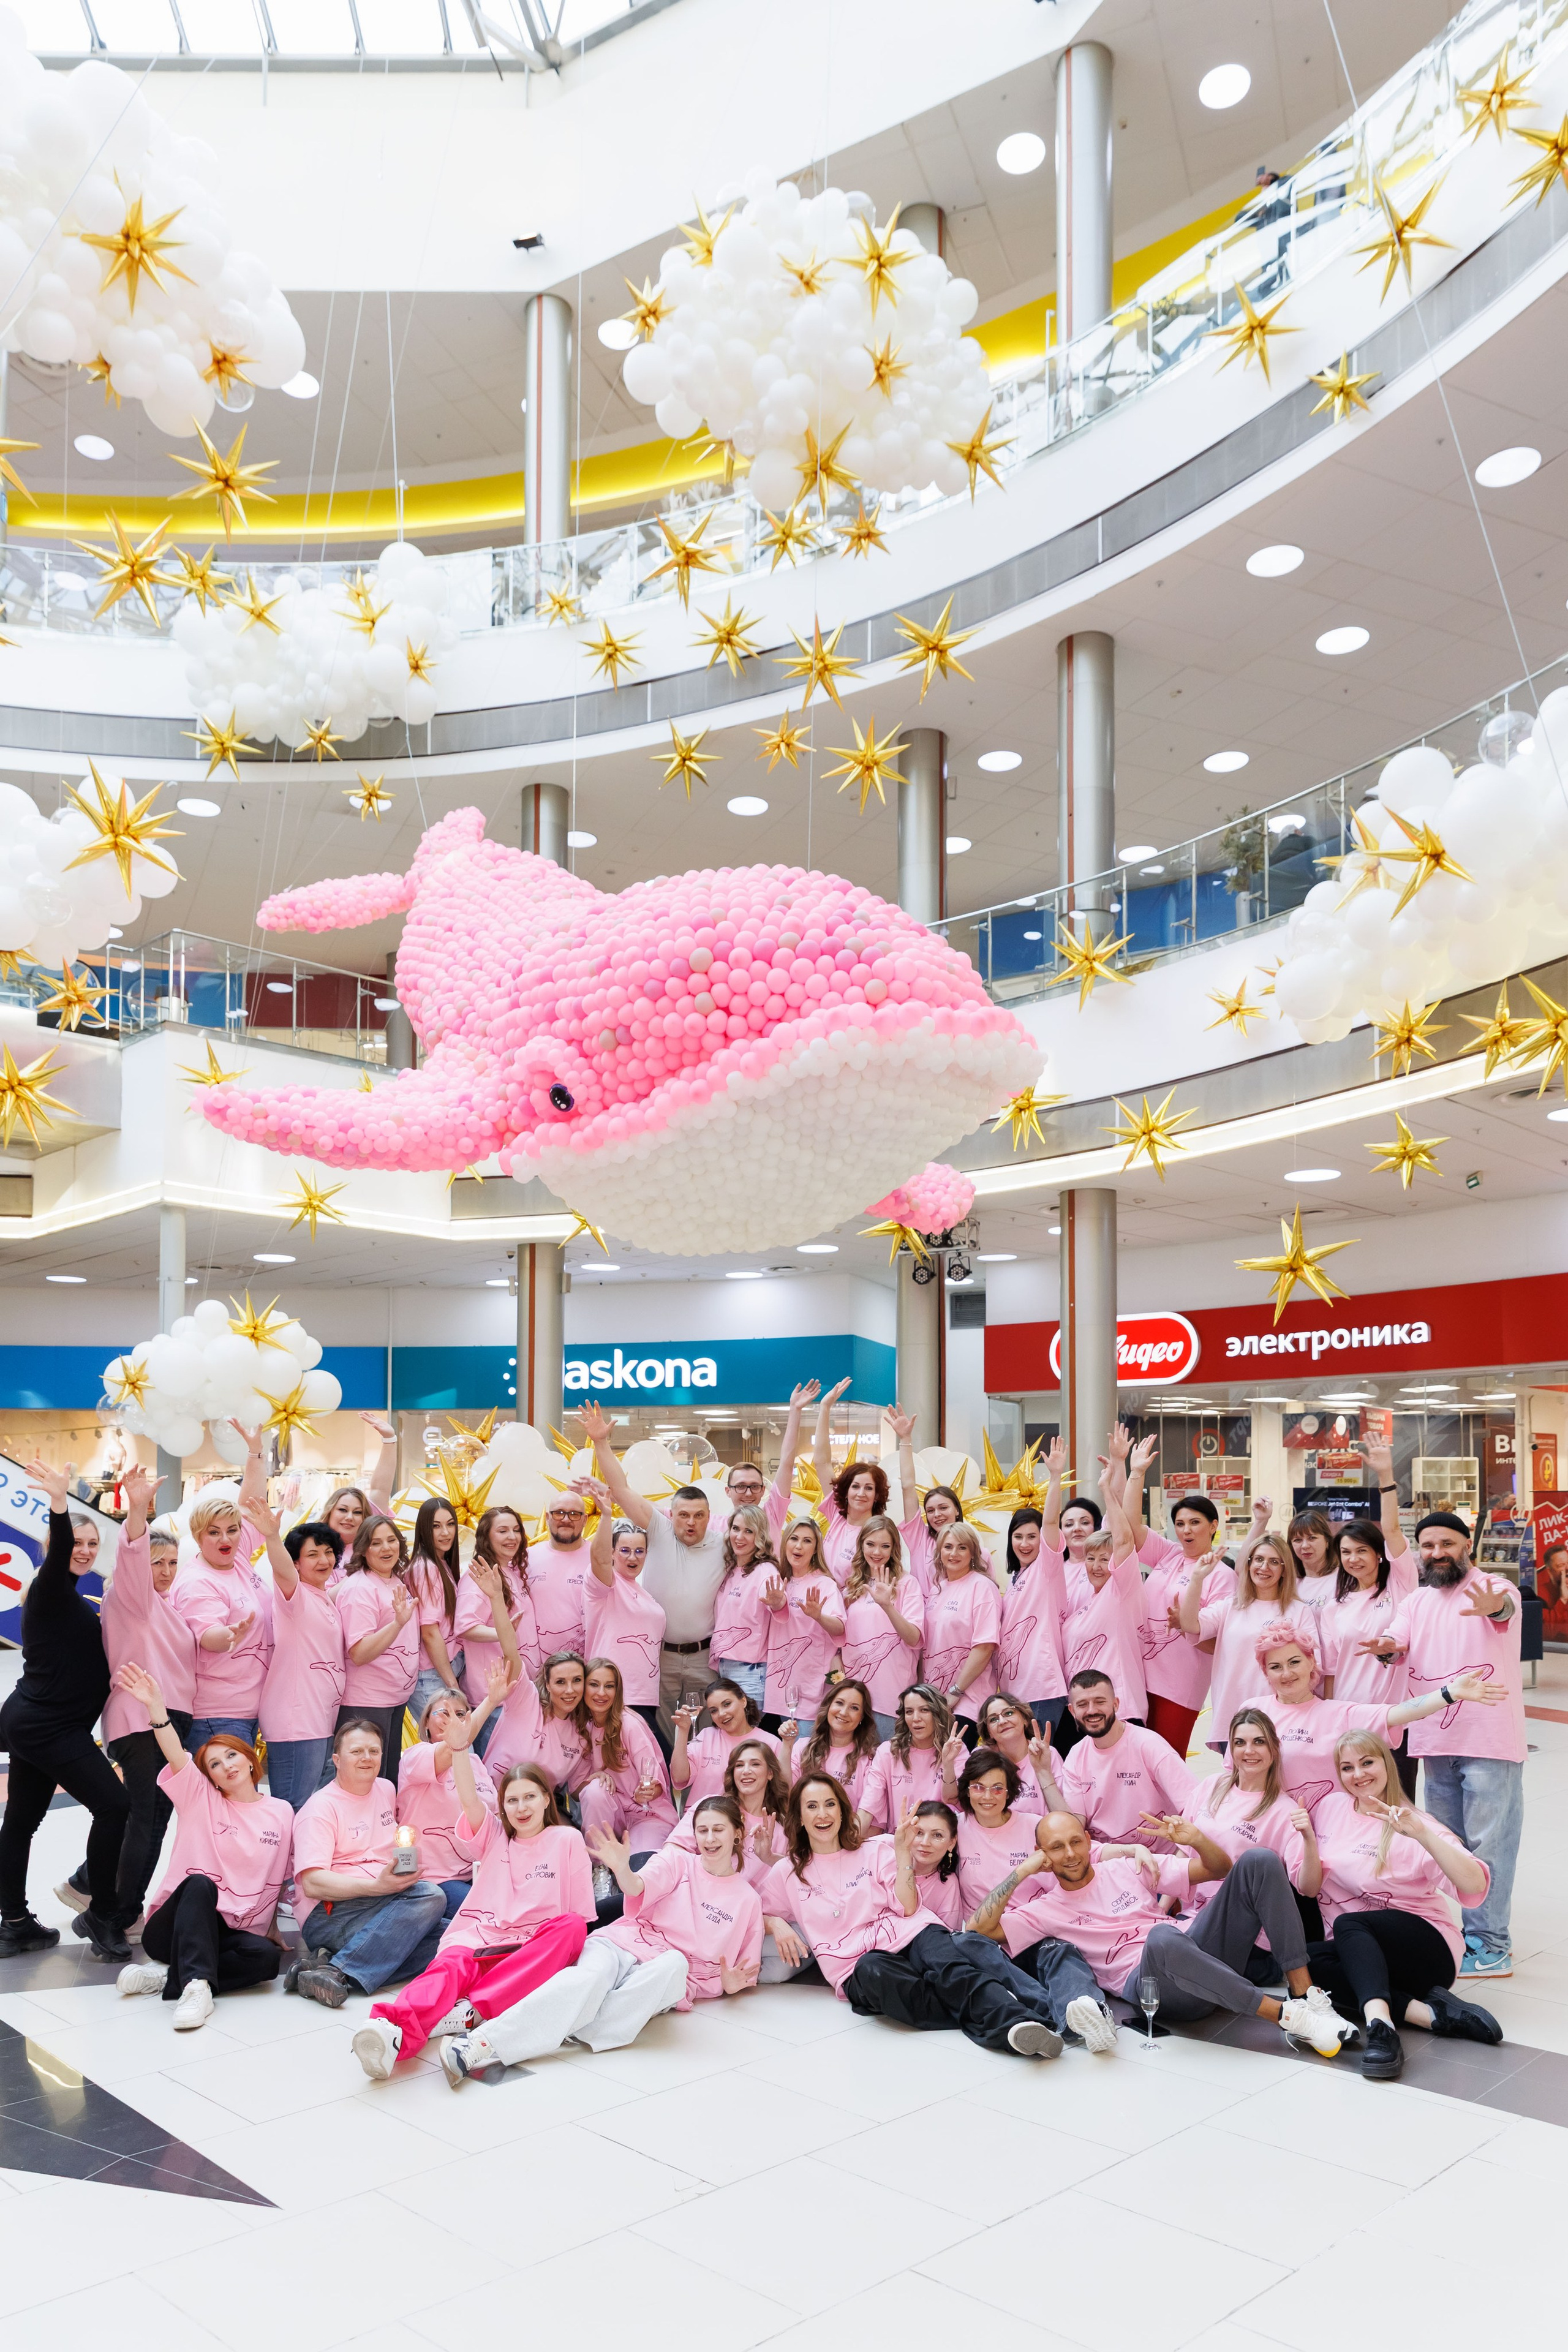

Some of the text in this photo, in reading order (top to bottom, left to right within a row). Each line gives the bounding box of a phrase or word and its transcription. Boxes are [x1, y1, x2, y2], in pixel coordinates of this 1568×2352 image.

[1225, 1321, 1431, 1360] электроника
[564, 1348, 717, 1390] askona
[811, 1434, 880, 1445] ПСТЕЛНОЕ
[1231, 1825, 1257, 1844] КУКАРИНА
[1240, 1821, 1256, 1834] ЗЛАТА
[701, 1902, 734, 1923] АЛЕКСАНДРА
[706, 1913, 721, 1924] ДУДА
